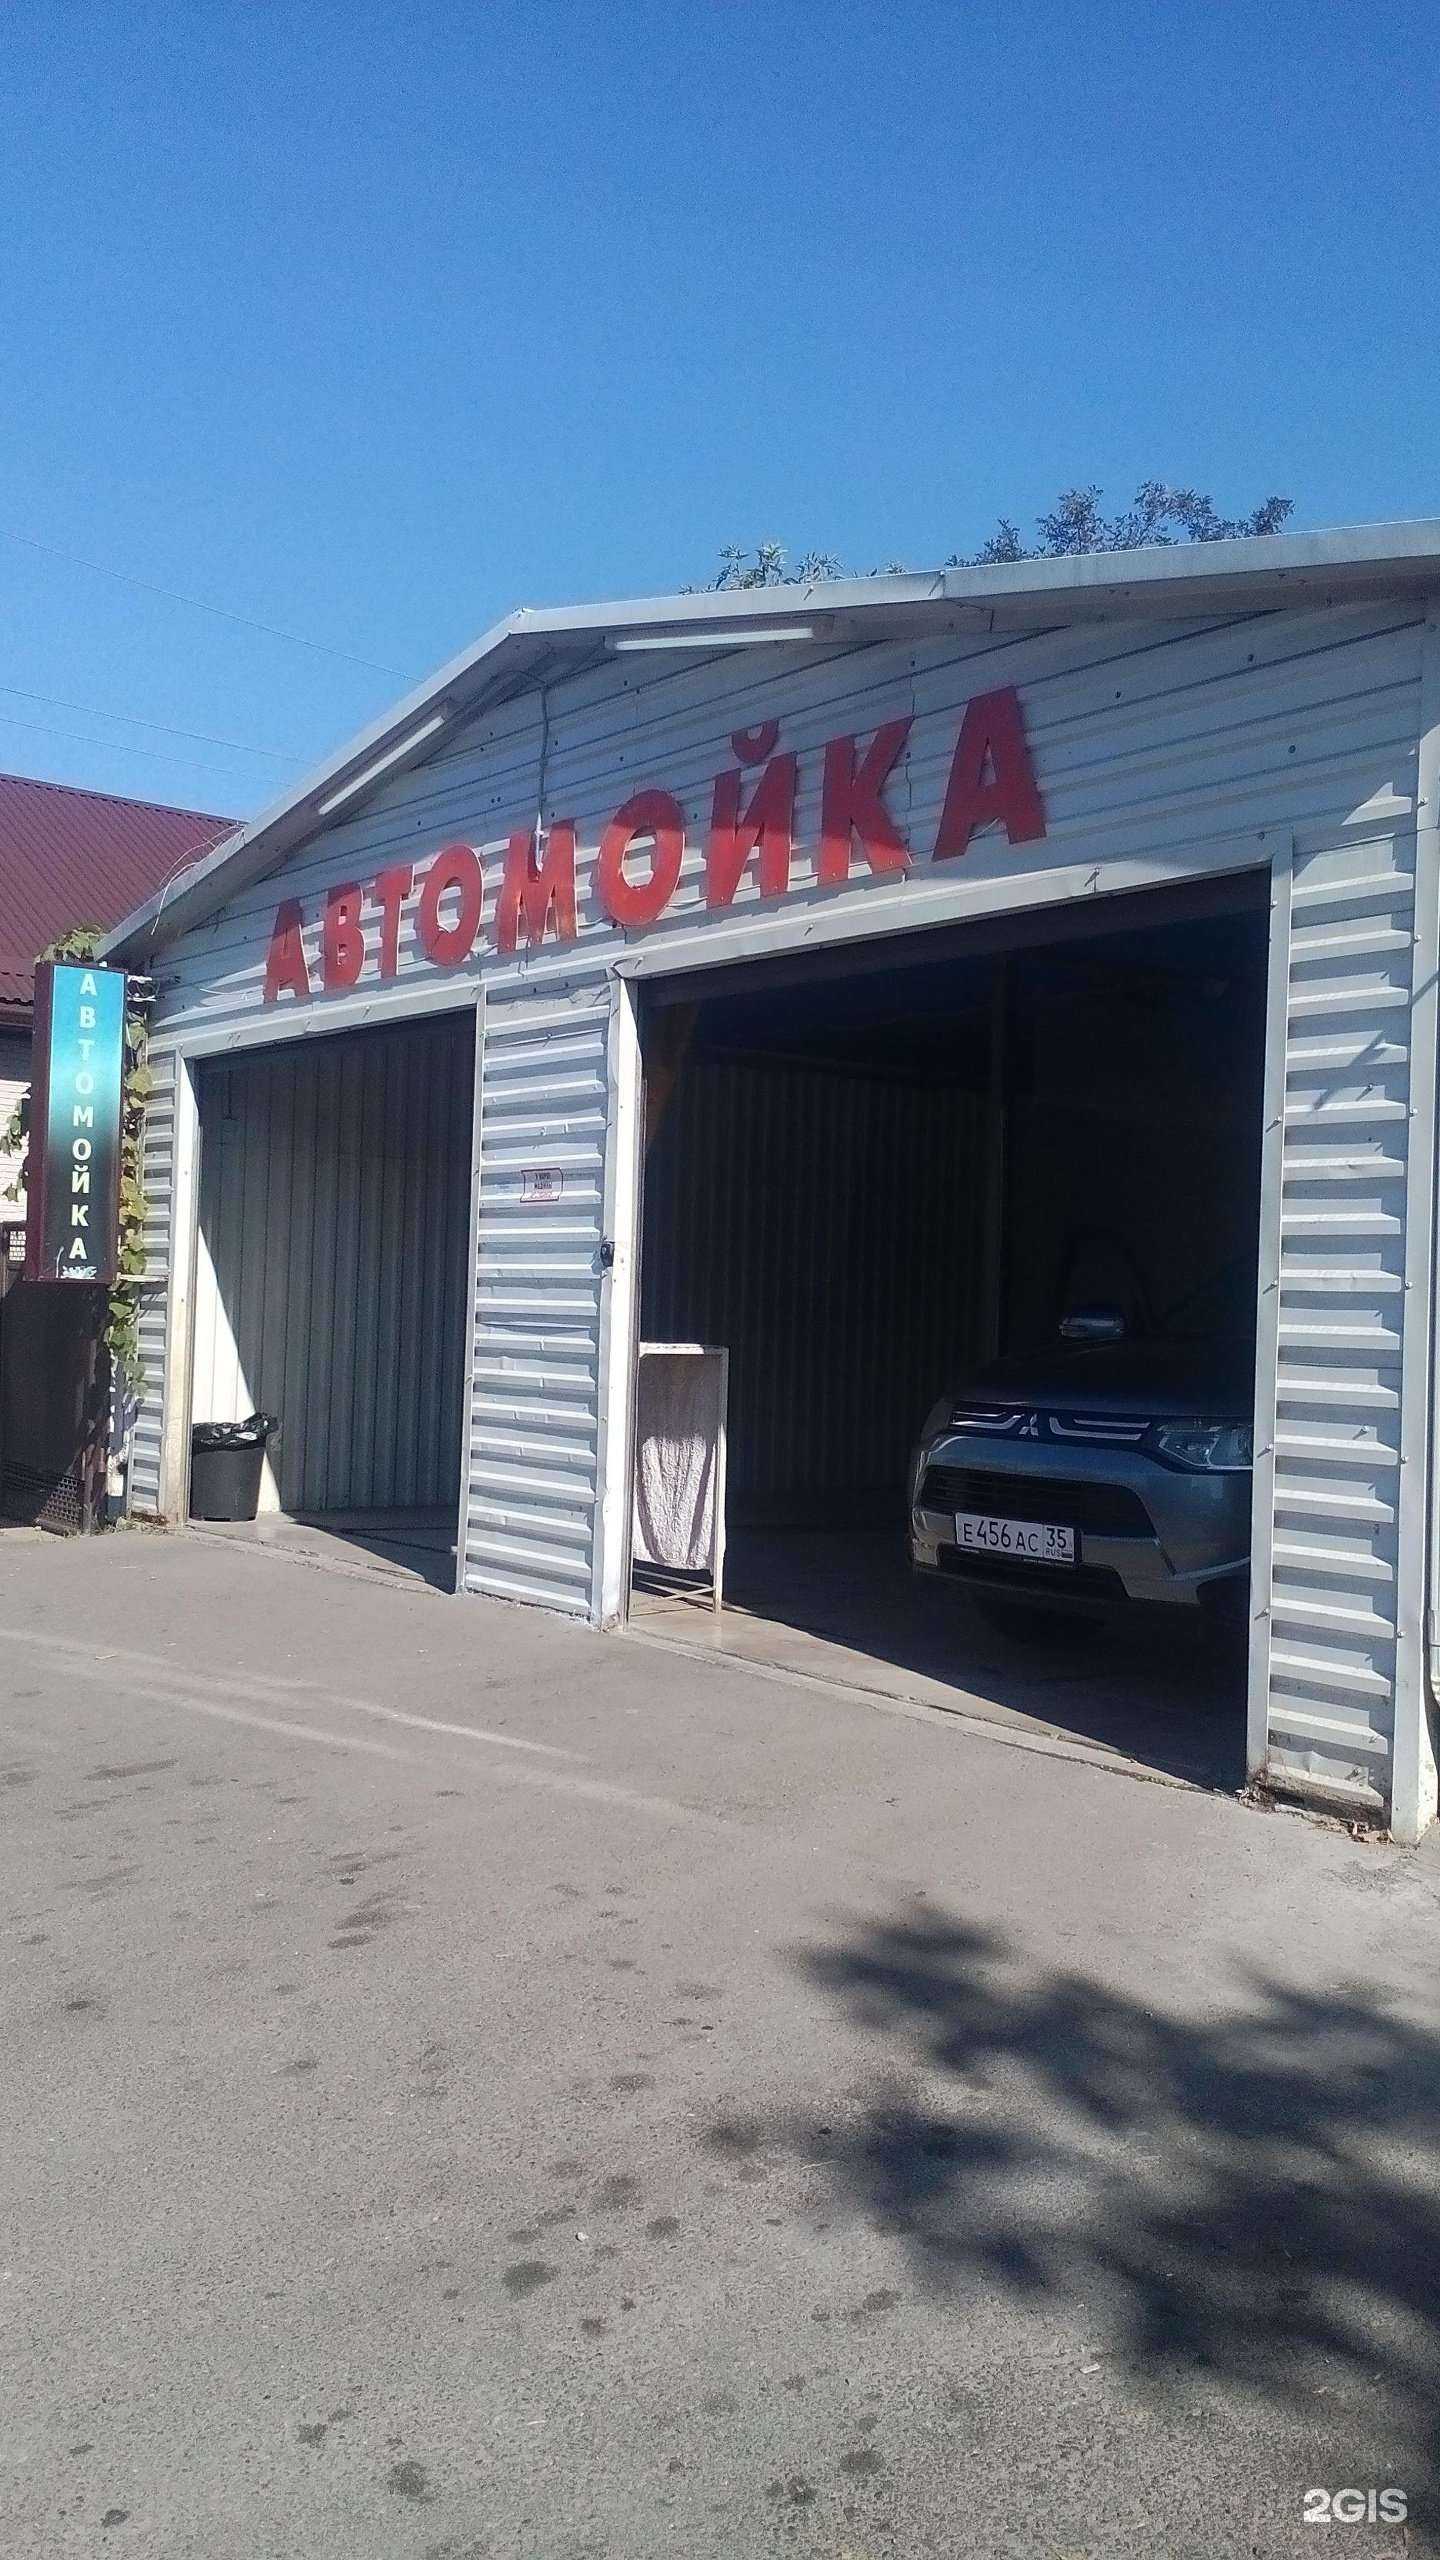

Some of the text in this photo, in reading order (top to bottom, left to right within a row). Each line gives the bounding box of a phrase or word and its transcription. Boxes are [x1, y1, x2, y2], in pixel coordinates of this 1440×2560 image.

[263, 685, 1046, 1001] АВТОМОЙКА
[68, 973, 97, 1260] АВТОМОЙКА
[1045, 1548, 1061, 1557] RUS
[1046, 1527, 1067, 1548] 35
